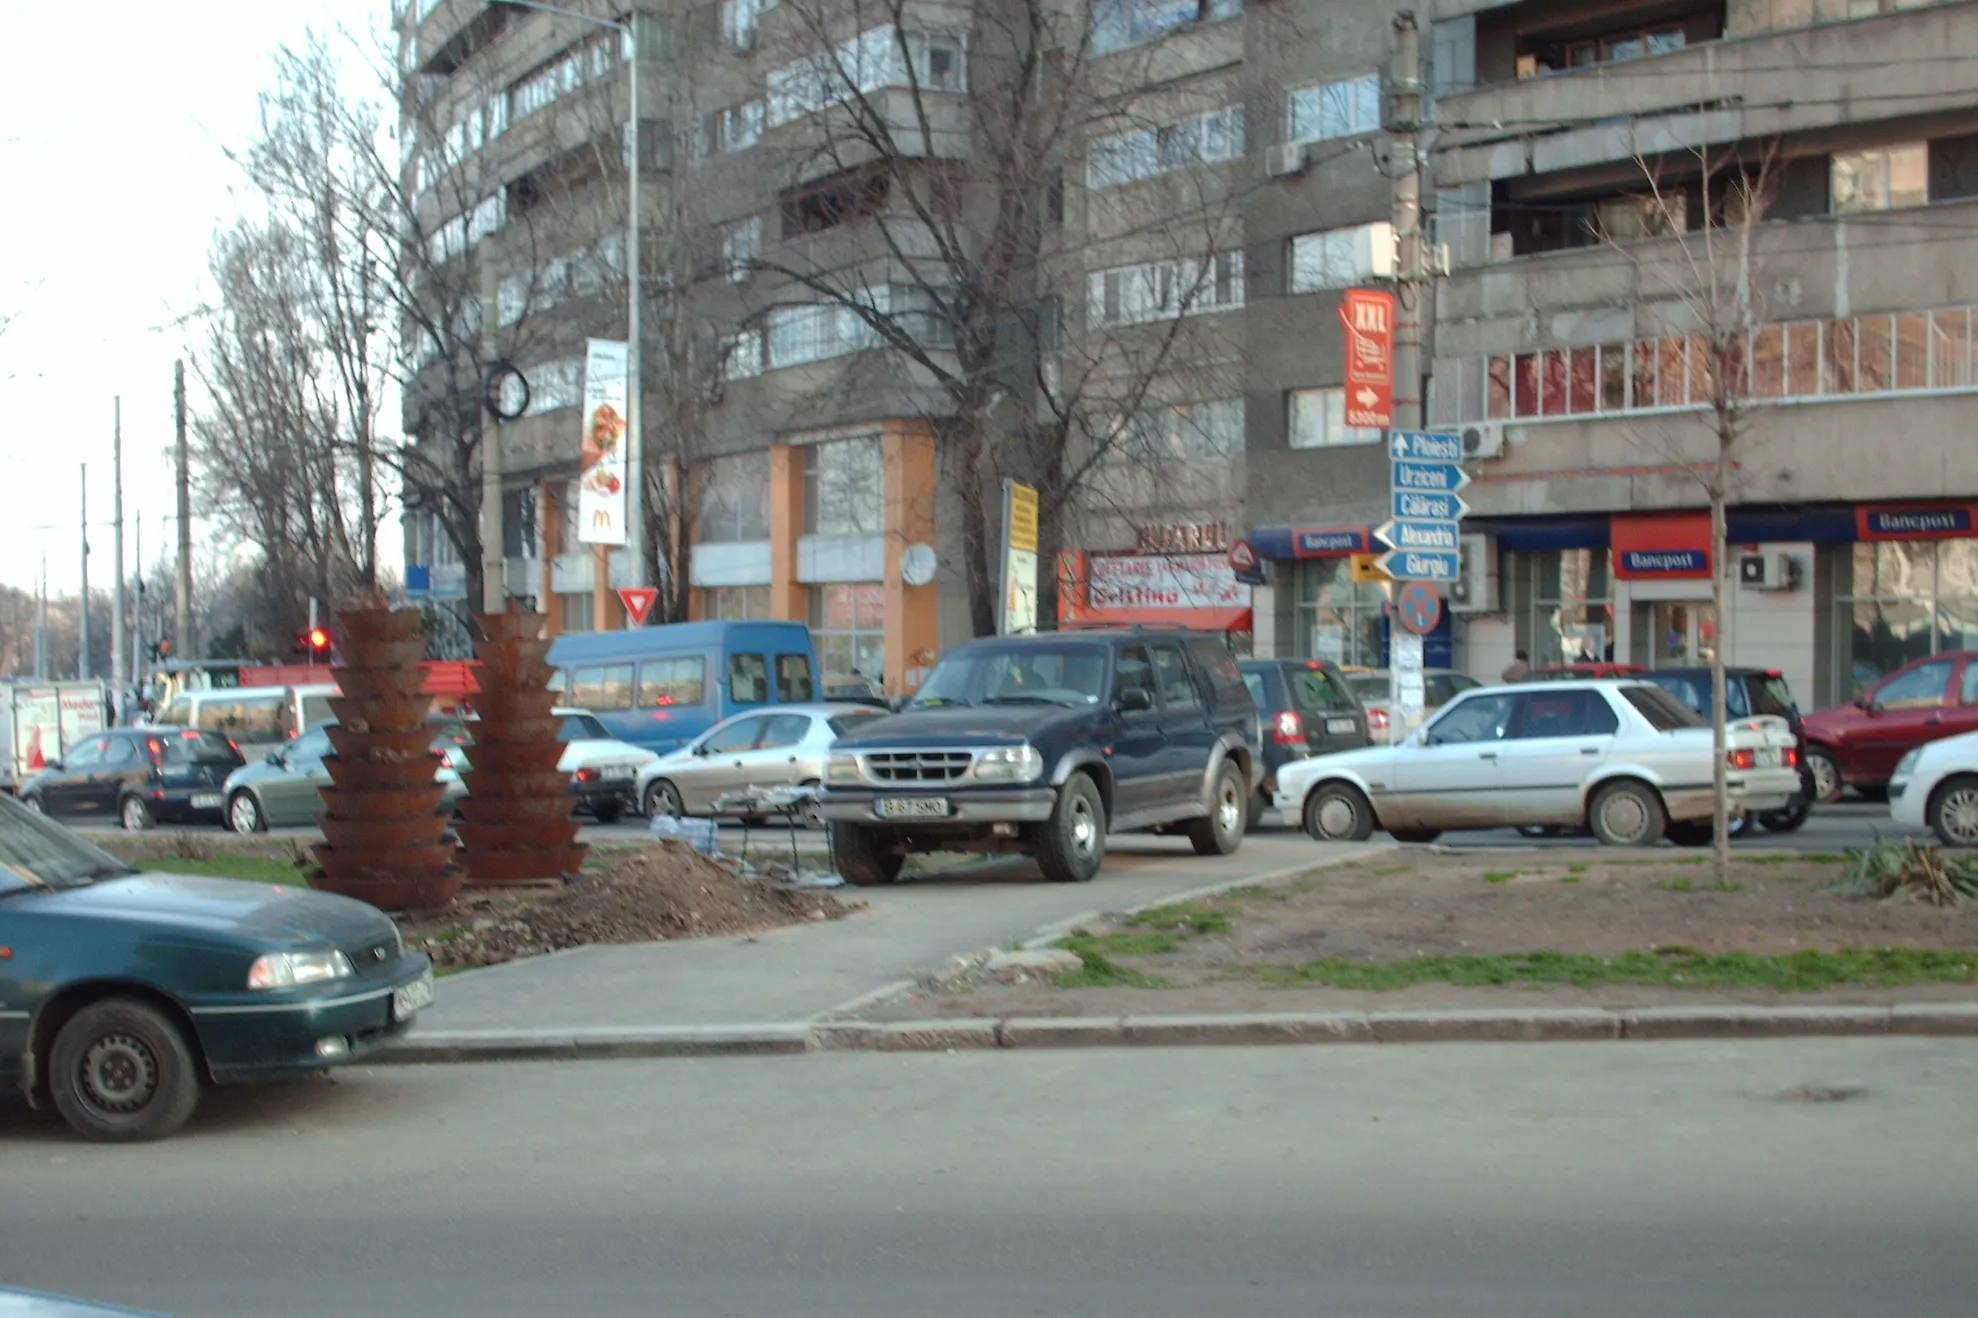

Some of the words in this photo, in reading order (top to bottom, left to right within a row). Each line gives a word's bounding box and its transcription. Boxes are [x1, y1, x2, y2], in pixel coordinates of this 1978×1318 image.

[1354, 302, 1387, 333] XXL
[1400, 461, 1448, 488] Urziceni
[1879, 511, 1956, 533] Bancpost
[1304, 531, 1353, 552] Bancpost
[1400, 523, 1455, 547] Alexandria
[1629, 550, 1694, 572] Bancpost
